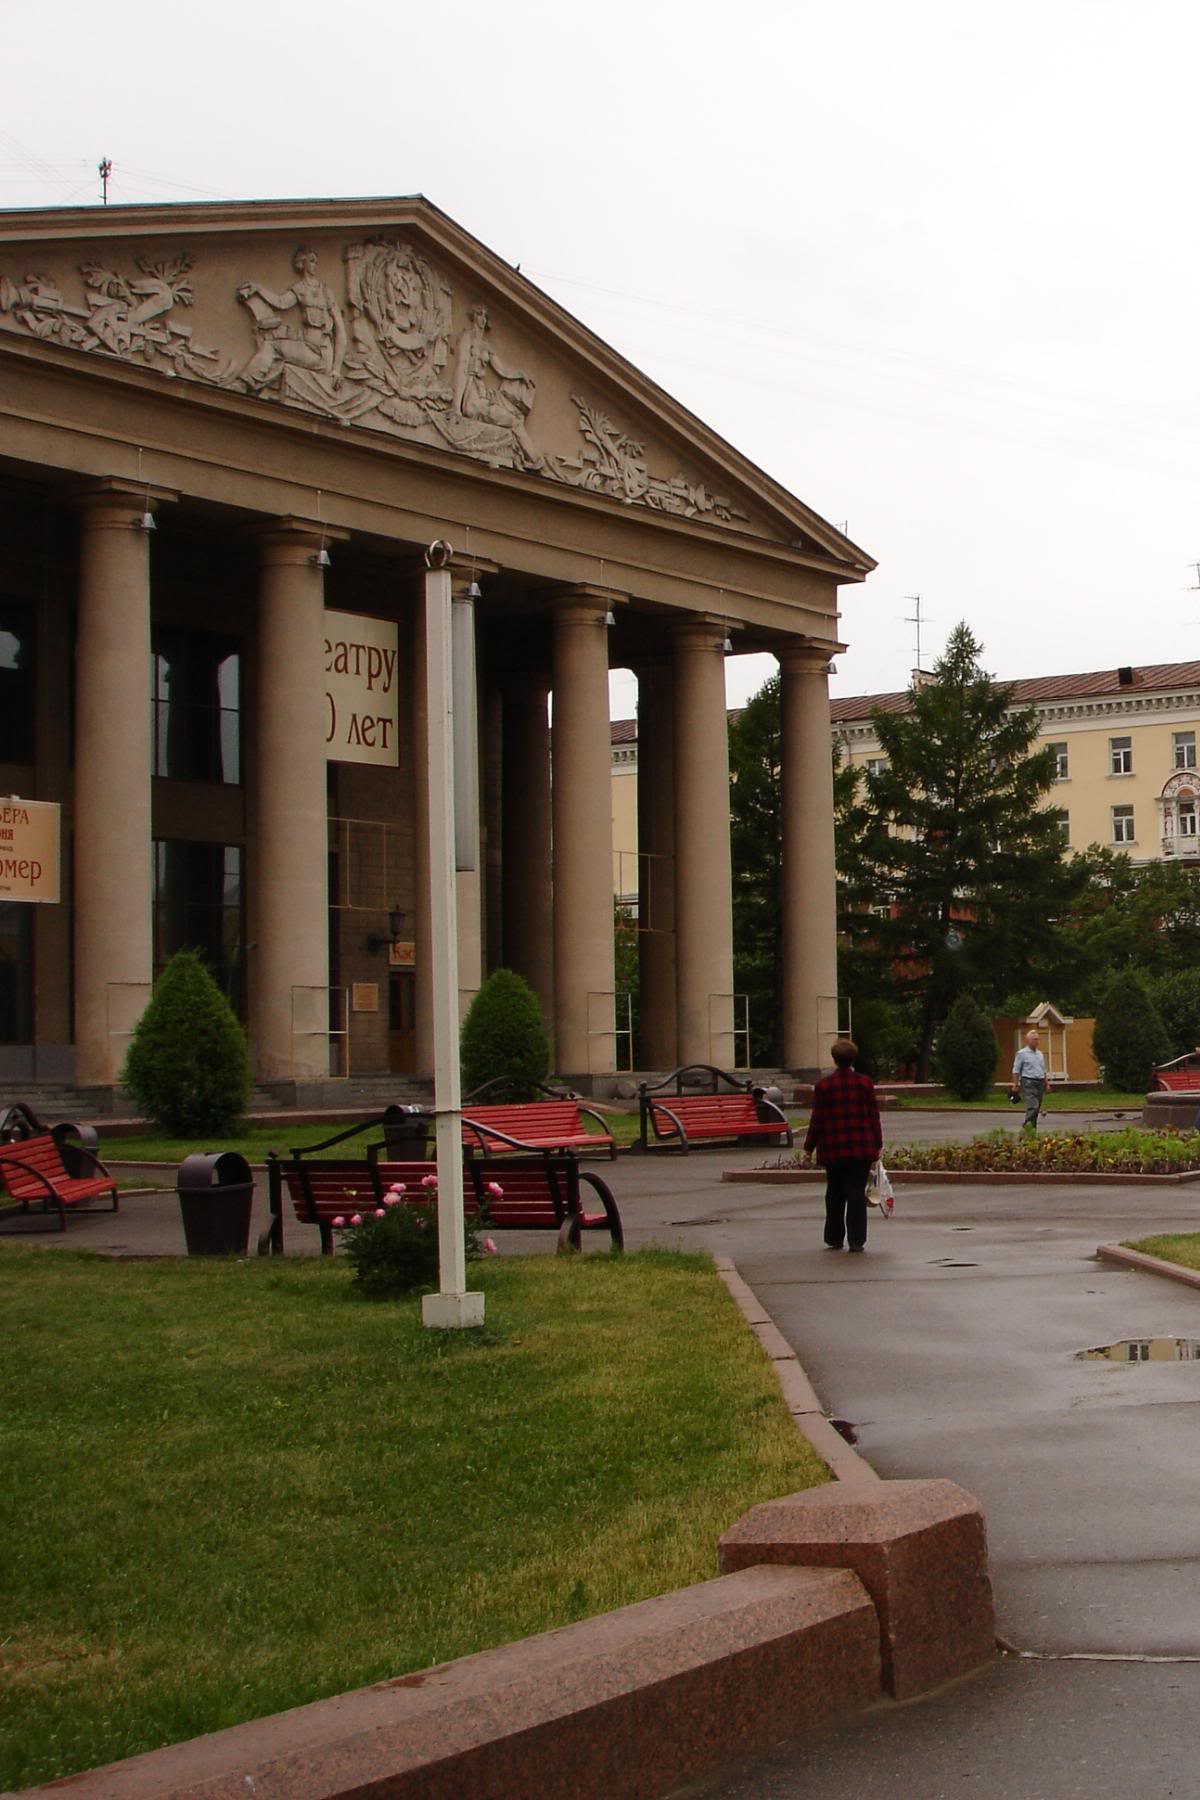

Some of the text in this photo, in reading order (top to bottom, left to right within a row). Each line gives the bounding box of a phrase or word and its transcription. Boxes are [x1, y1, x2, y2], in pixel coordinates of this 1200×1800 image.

[347, 713, 393, 749] лет
[0, 807, 30, 825] ЕРА
[0, 859, 42, 887] мер
